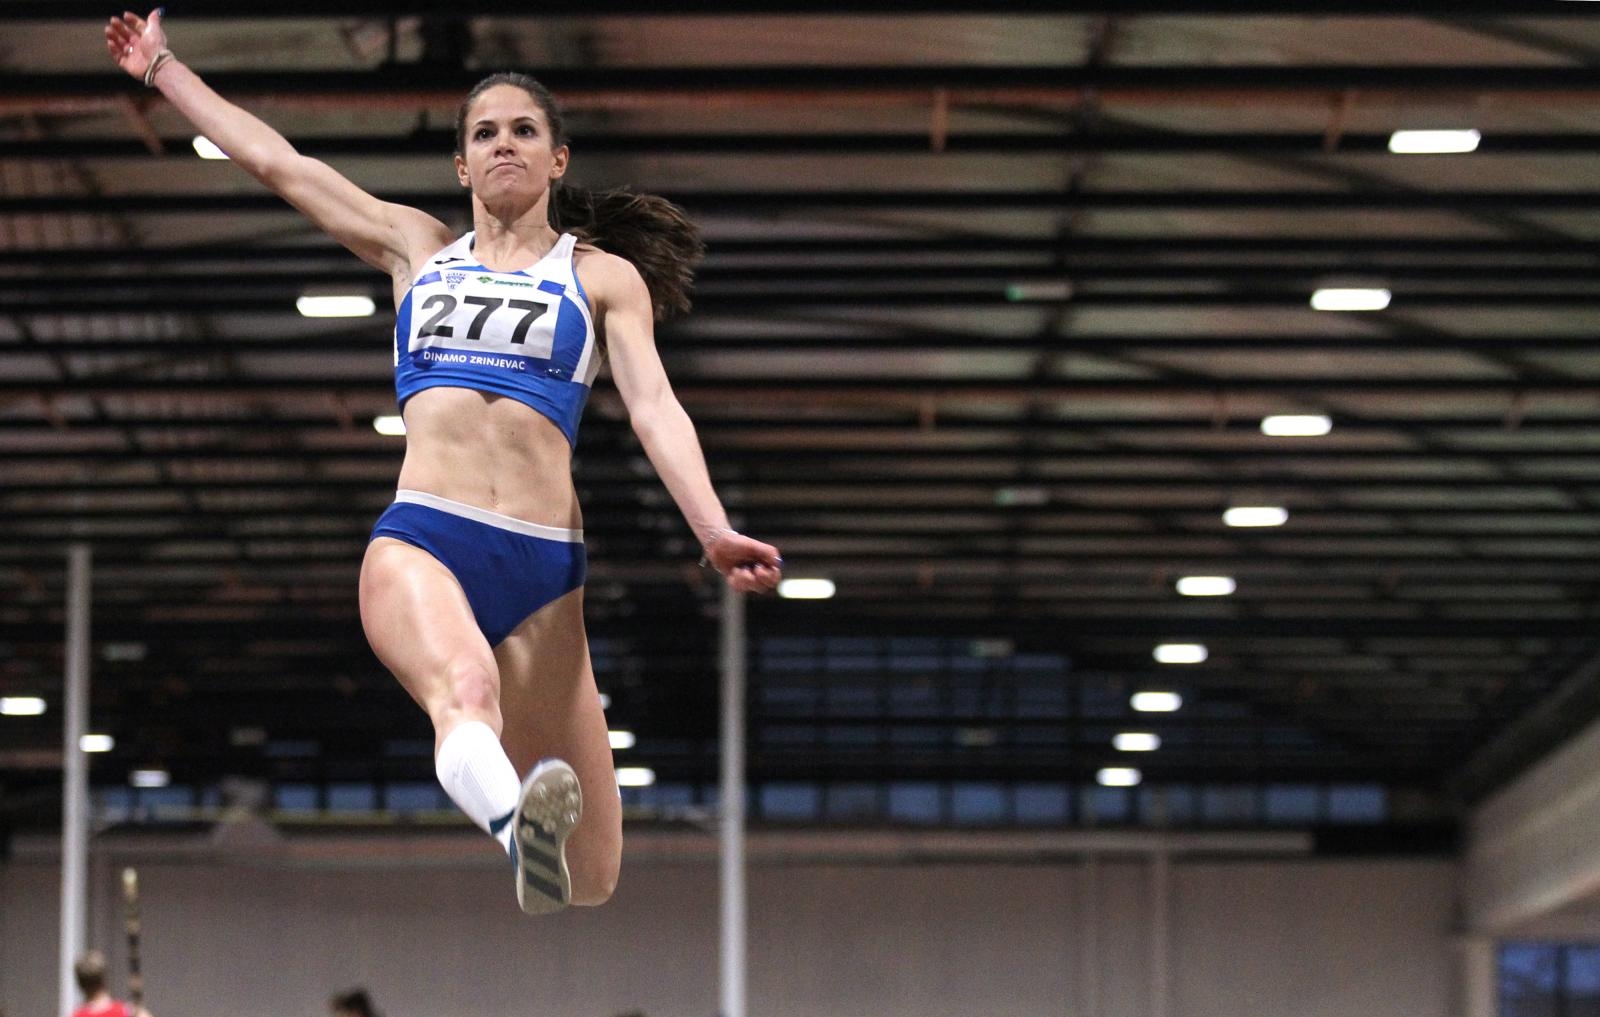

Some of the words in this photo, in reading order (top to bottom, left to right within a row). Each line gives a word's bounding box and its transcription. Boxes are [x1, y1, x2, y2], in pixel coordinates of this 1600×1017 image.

[417, 294, 549, 345] 277
[423, 351, 467, 363] DINAMO
[470, 355, 526, 370] ZRINJEVAC
